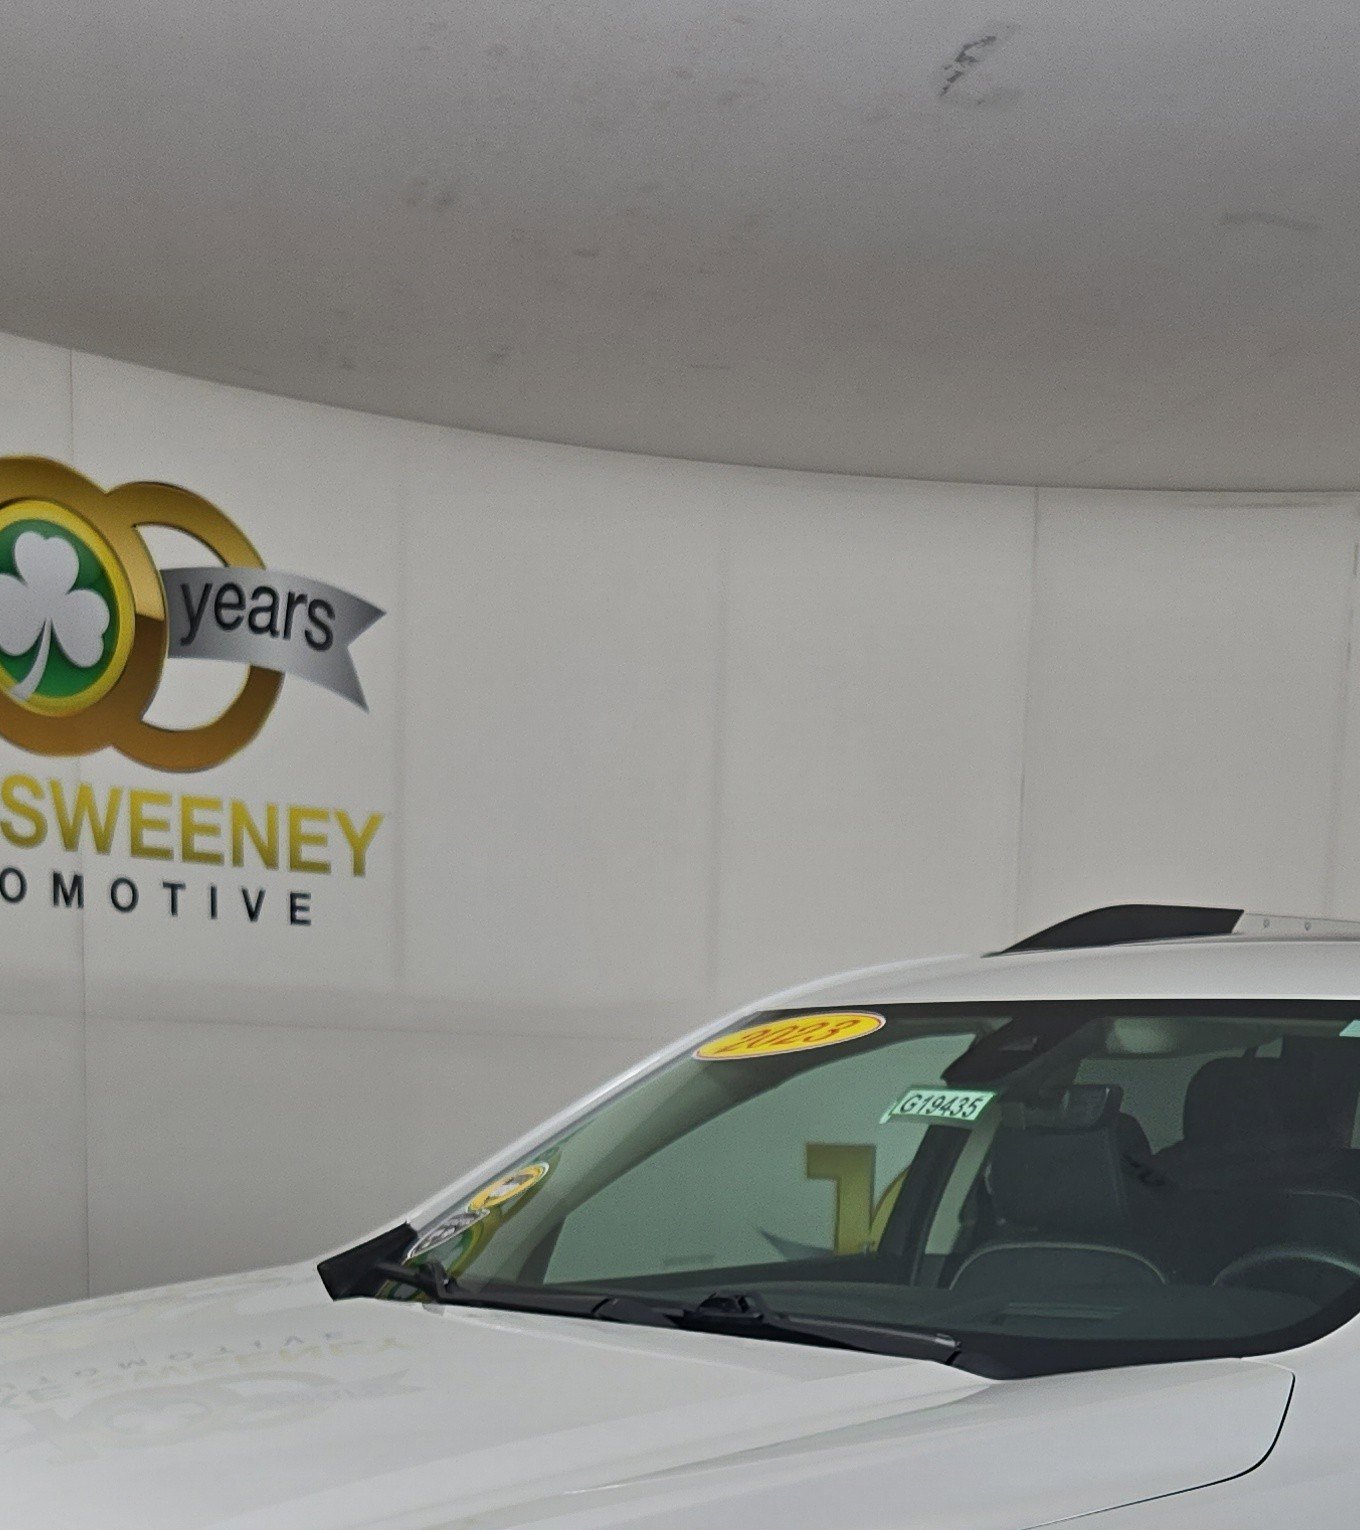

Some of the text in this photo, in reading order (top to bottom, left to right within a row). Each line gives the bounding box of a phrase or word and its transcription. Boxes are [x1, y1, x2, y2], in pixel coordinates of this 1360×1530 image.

[179, 582, 336, 651] years
[714, 1019, 861, 1054] 2023
[900, 1094, 983, 1119] G19435
